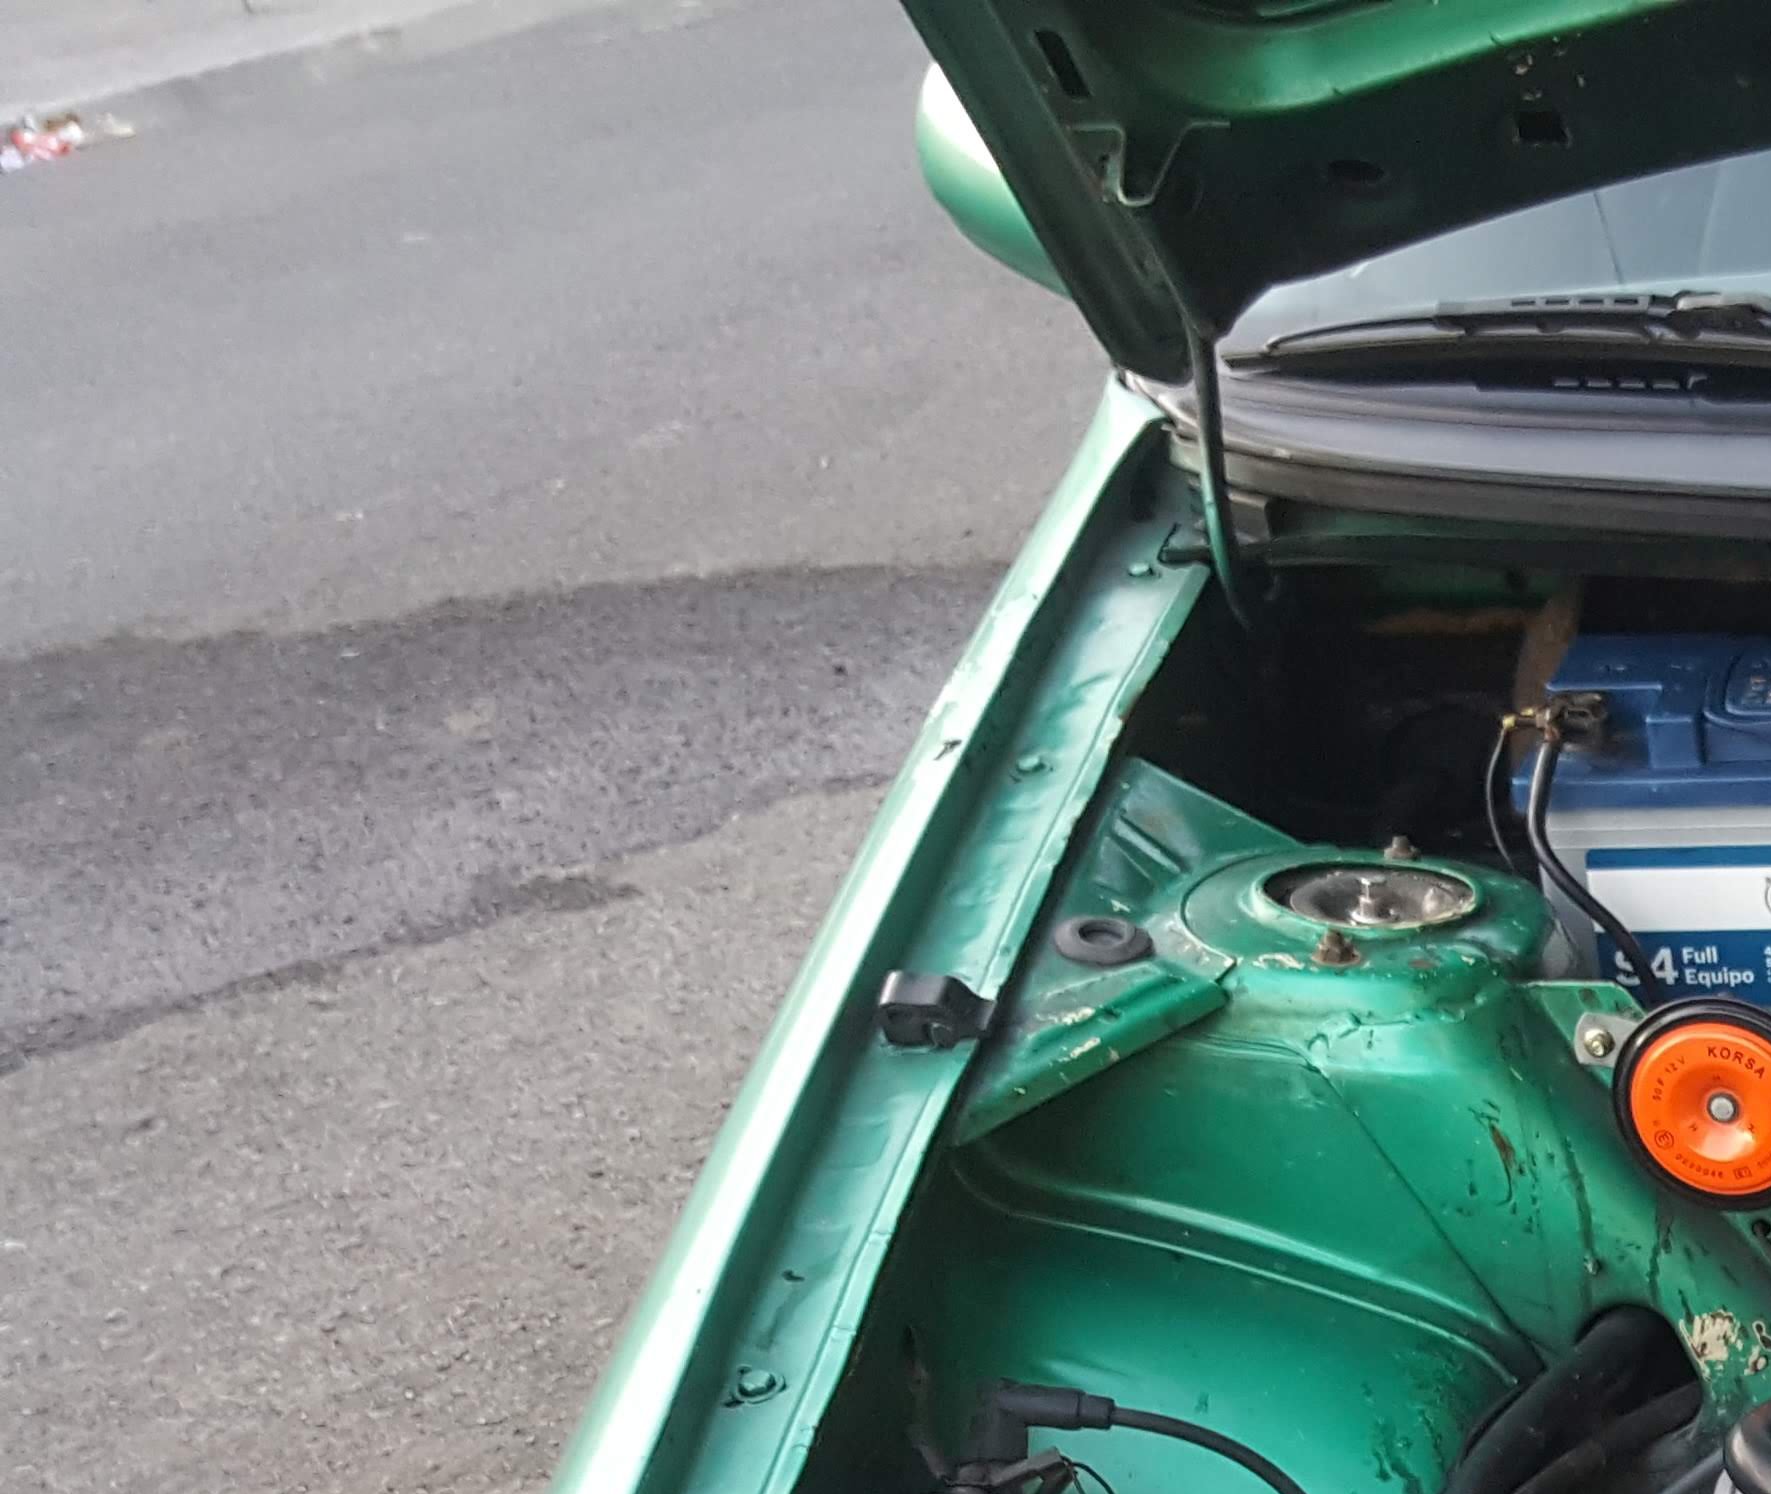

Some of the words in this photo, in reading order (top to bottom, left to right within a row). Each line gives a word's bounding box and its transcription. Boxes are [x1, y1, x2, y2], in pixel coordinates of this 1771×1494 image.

[1682, 946, 1719, 965] Full
[1685, 967, 1755, 988] Equipo
[1706, 1045, 1767, 1080] KORSA
